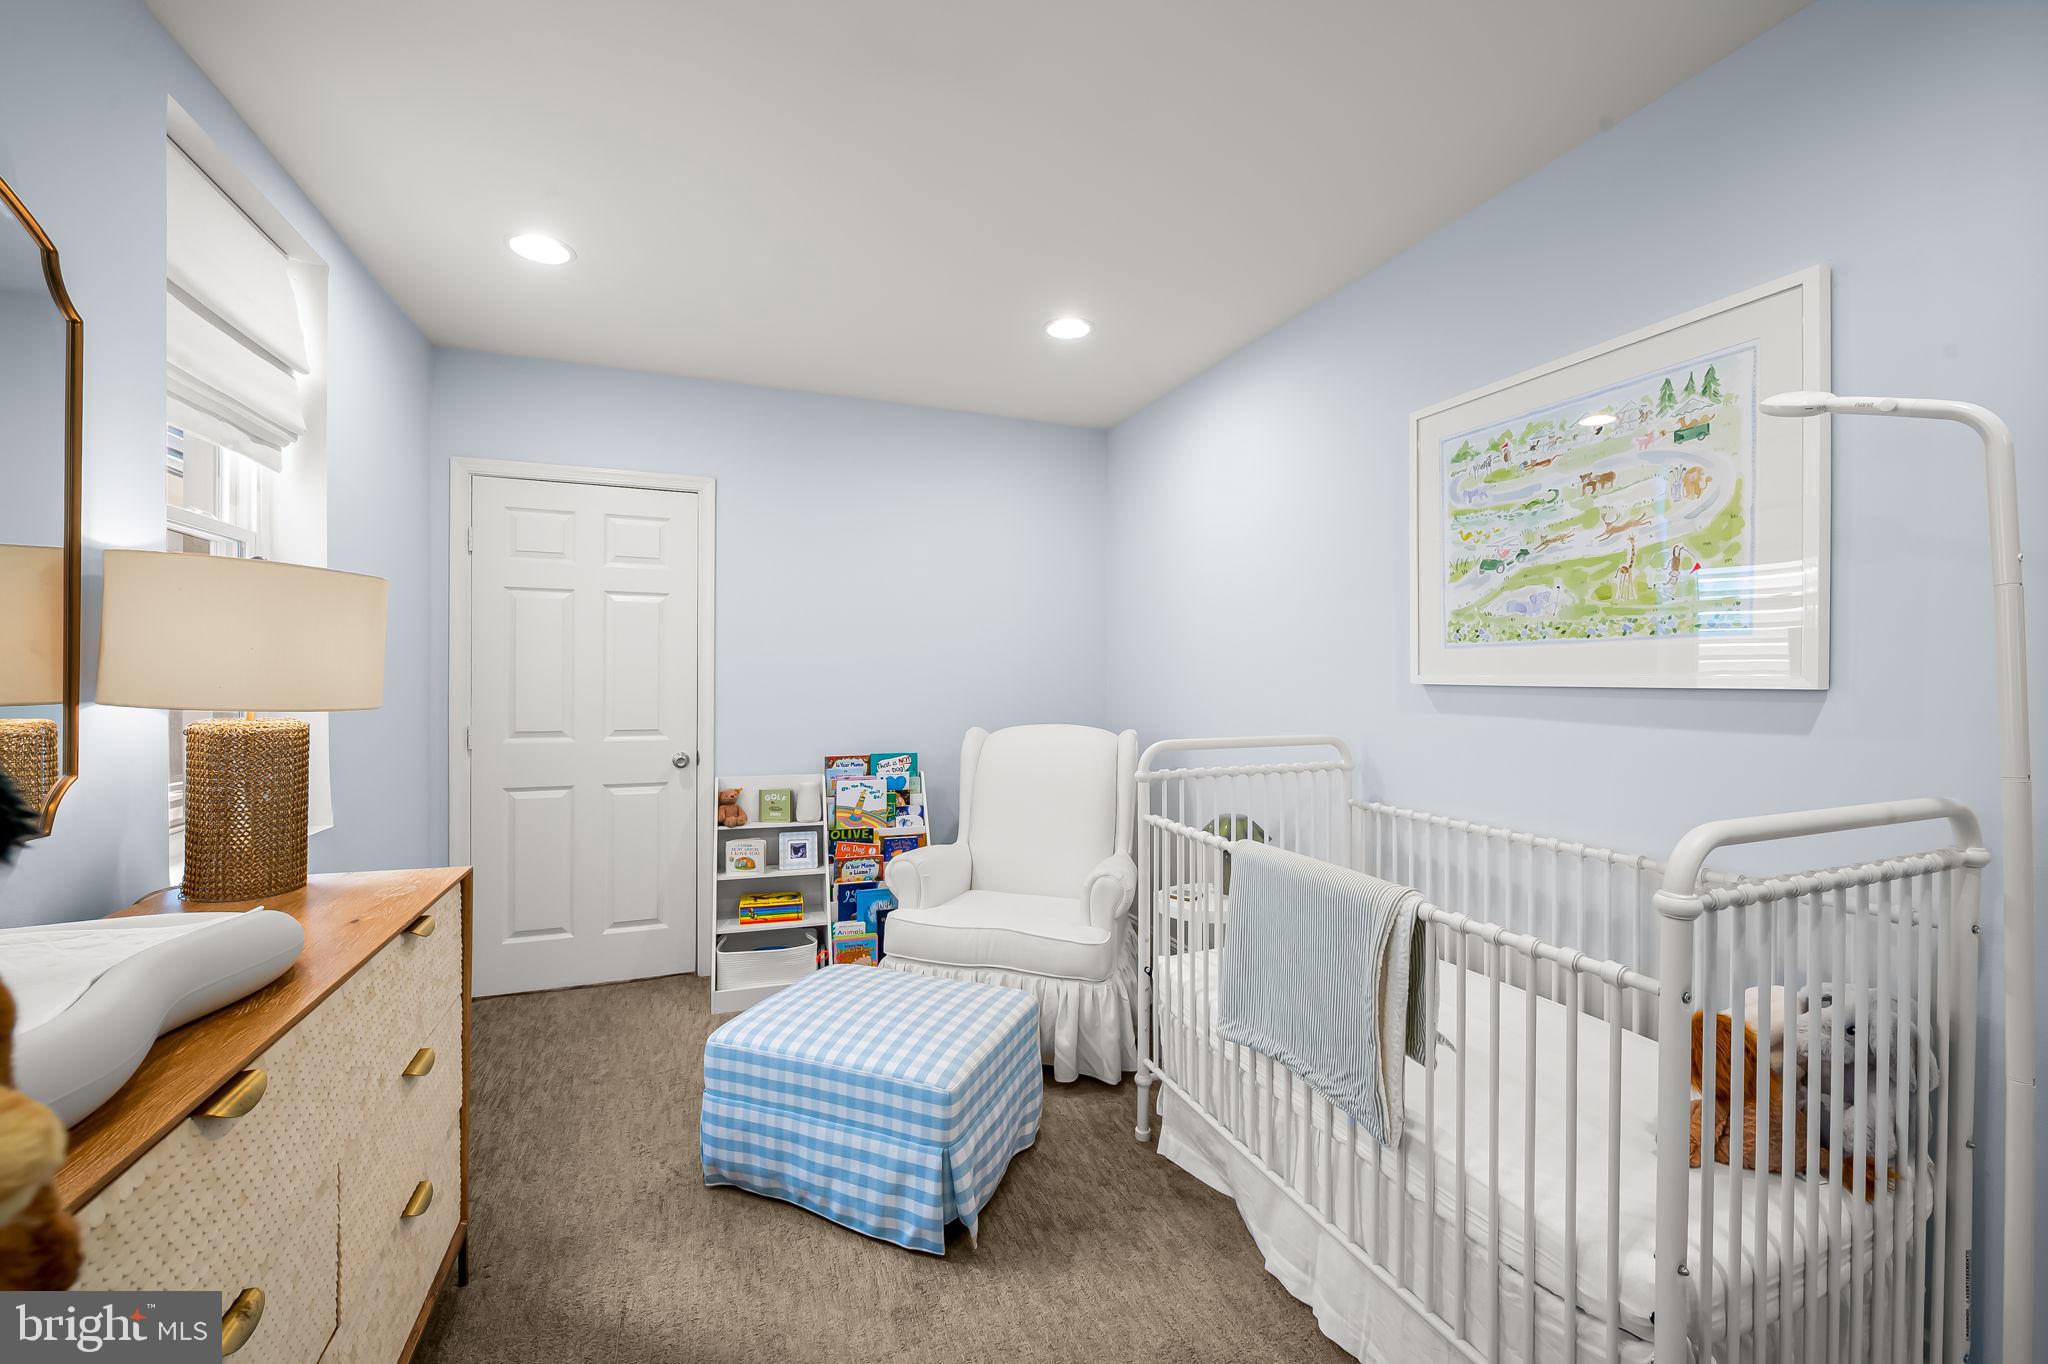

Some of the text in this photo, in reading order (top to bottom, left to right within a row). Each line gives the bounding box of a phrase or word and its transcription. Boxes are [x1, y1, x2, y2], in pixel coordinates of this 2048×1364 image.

[898, 756, 910, 764] NOT
[764, 793, 787, 801] GOLF
[830, 829, 873, 840] OLIVE,
